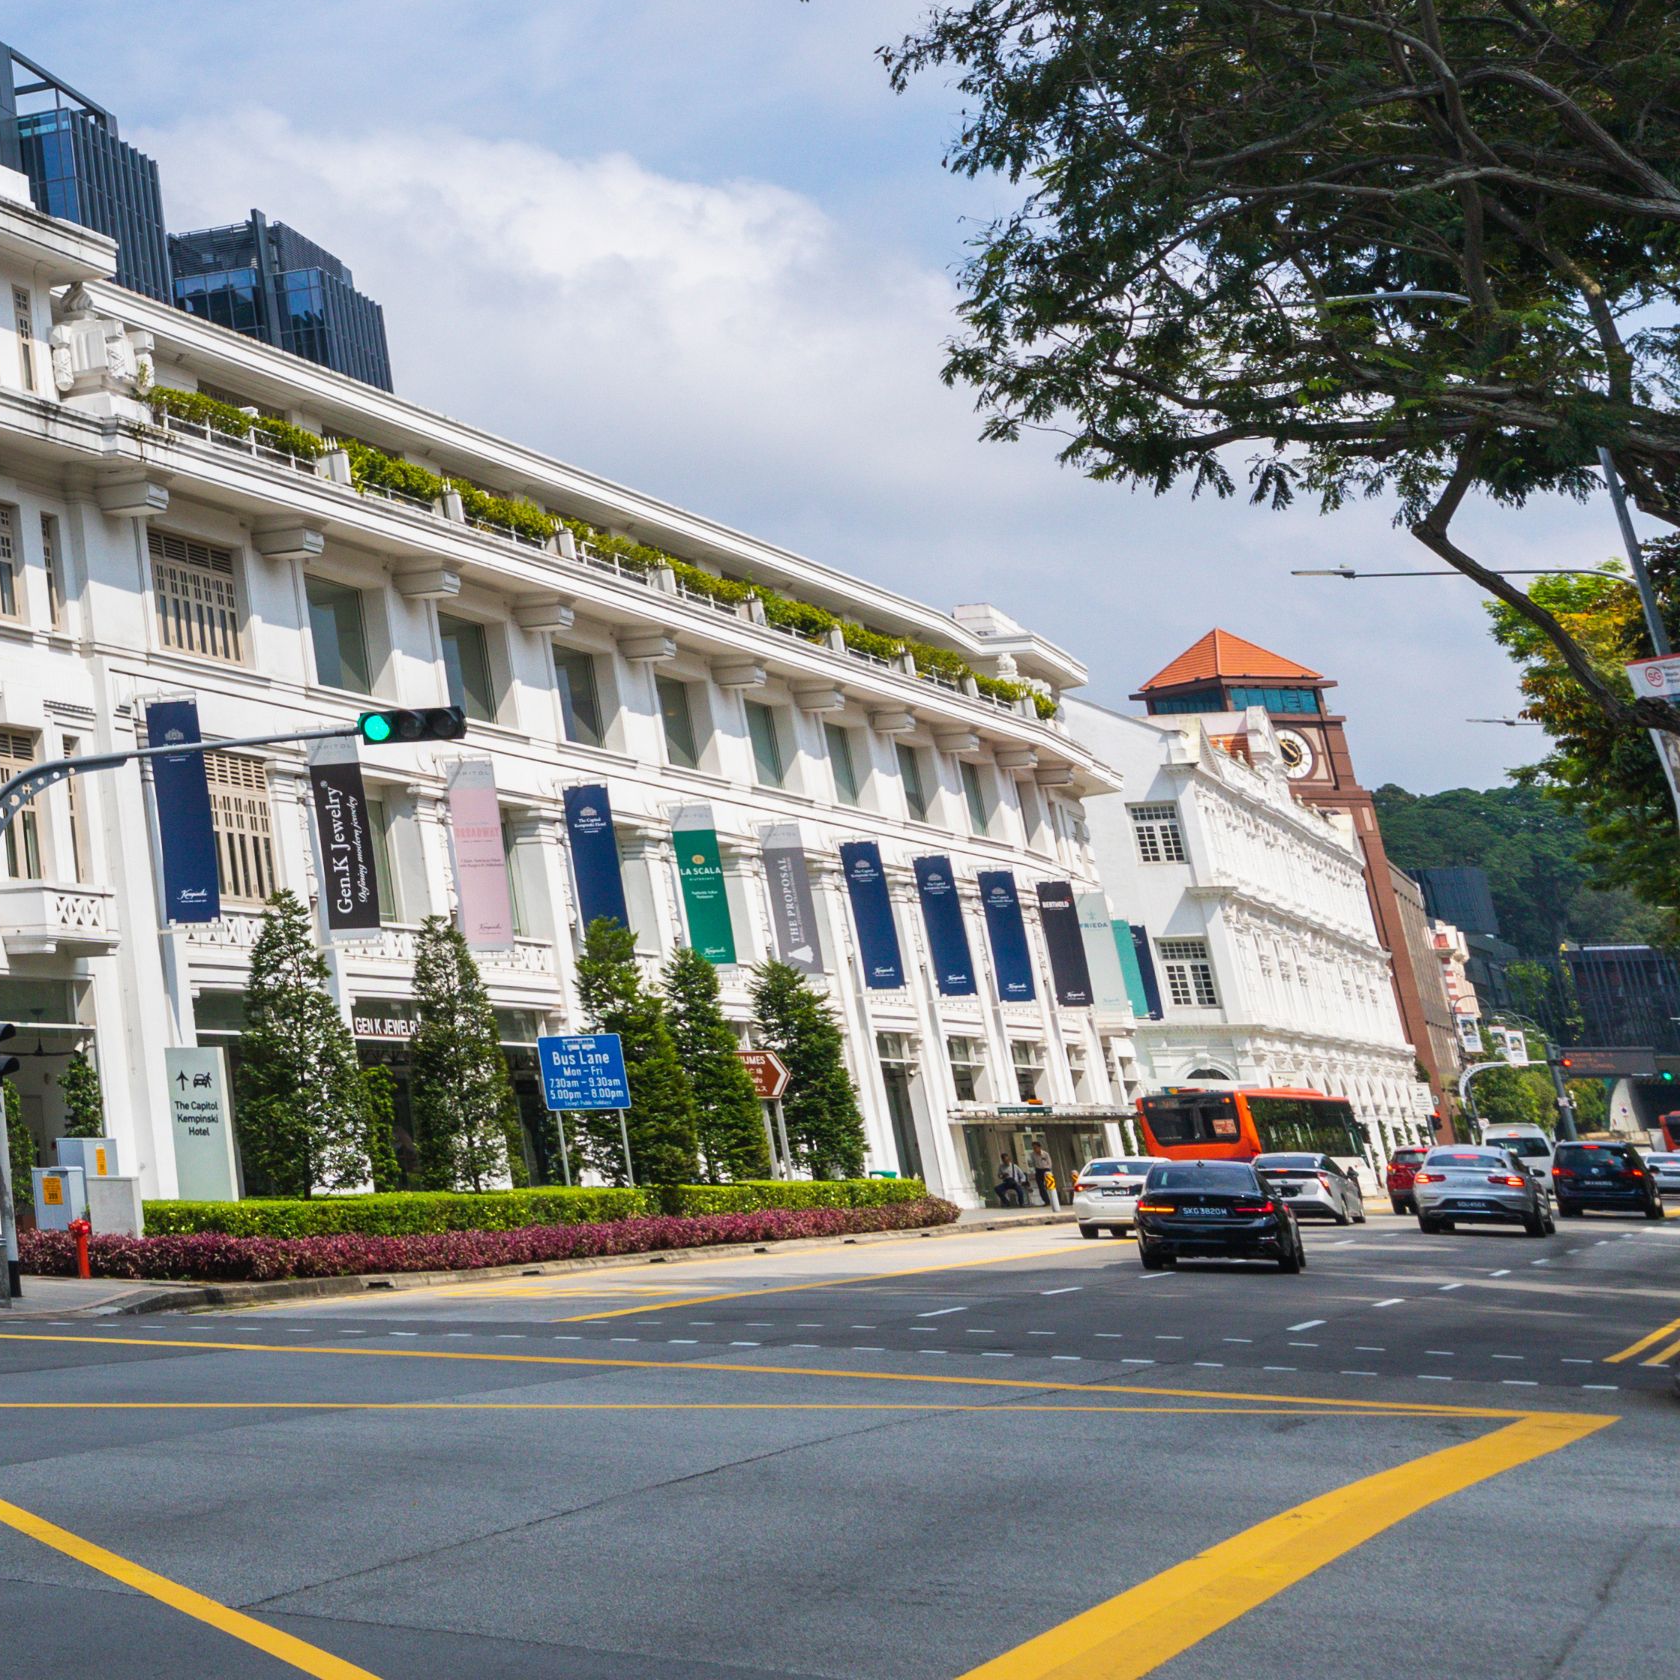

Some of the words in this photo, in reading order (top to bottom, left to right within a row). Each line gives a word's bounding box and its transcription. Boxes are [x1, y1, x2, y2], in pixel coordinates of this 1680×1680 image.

[680, 868, 692, 876] LA
[694, 867, 722, 876] SCALA
[777, 857, 797, 919] PROPOSAL
[789, 919, 800, 944] THE
[355, 1017, 373, 1034] GEN
[374, 1018, 382, 1034] K
[552, 1051, 575, 1065] Bus
[579, 1051, 610, 1065] Lane
[563, 1068, 581, 1076] Mon
[591, 1067, 603, 1076] Fri
[550, 1078, 580, 1088] 7.30am
[589, 1077, 621, 1087] 9.30am
[551, 1089, 582, 1100] 5.00pm
[591, 1088, 624, 1099] 8.00pm
[174, 1101, 189, 1110] The
[191, 1101, 218, 1112] Capitol
[177, 1114, 219, 1125] Kempinski
[188, 1126, 210, 1137] Hotel
